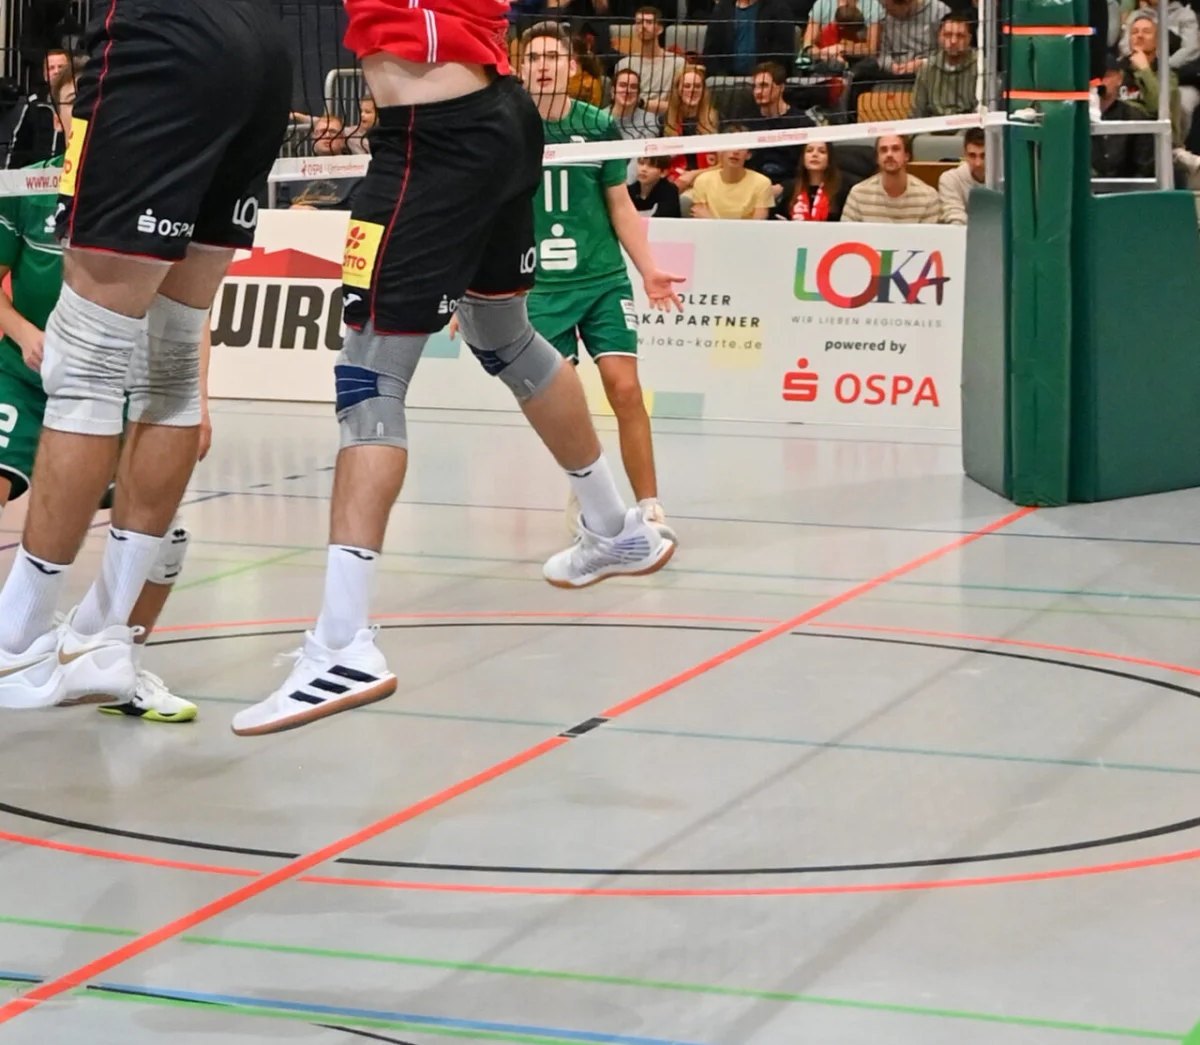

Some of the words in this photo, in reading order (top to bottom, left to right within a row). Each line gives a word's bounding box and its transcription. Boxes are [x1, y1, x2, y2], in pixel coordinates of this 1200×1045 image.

[26, 175, 61, 189] www.o
[544, 169, 568, 212] 11
[157, 218, 195, 237] OSPA
[794, 242, 951, 309] LOKA
[675, 314, 760, 328] PARTNER
[824, 340, 886, 352] powered
[890, 341, 907, 354] by
[834, 373, 940, 407] OSPA
